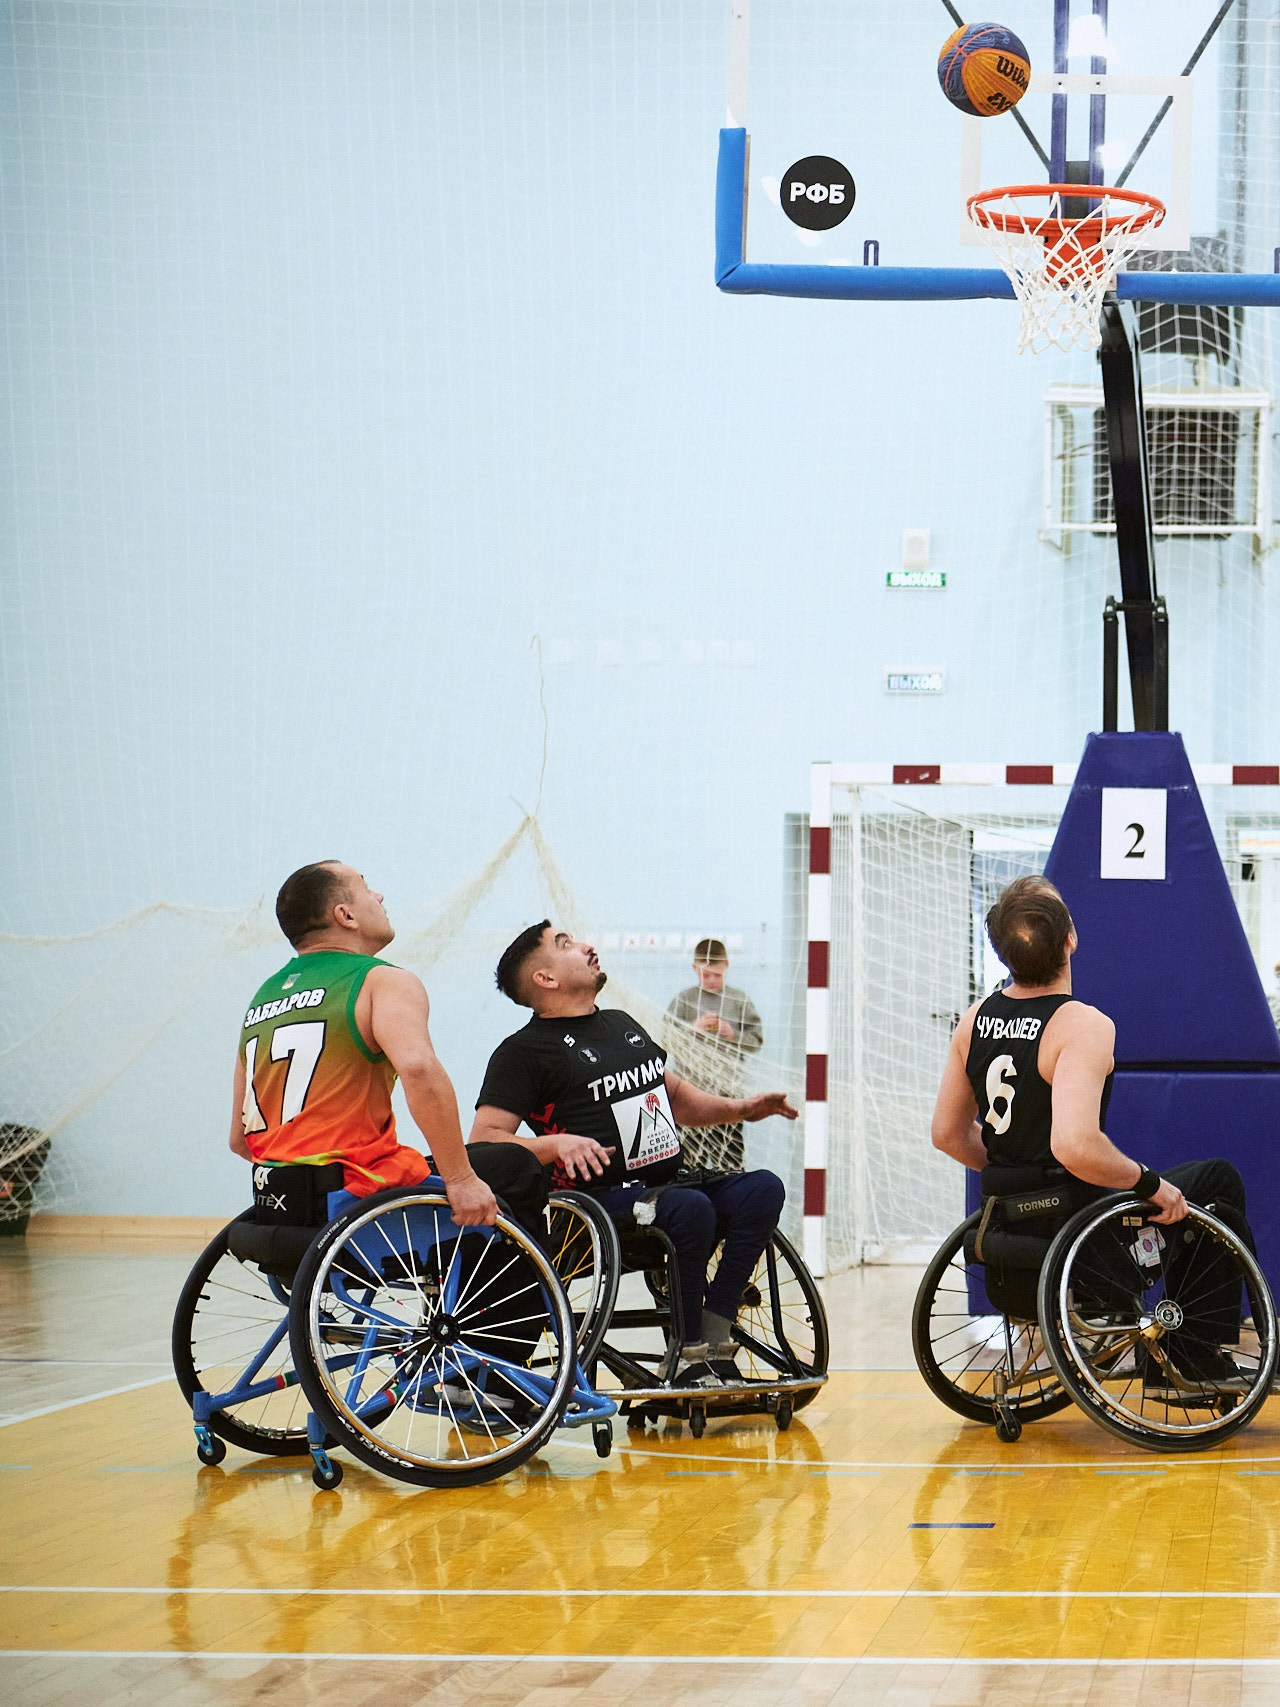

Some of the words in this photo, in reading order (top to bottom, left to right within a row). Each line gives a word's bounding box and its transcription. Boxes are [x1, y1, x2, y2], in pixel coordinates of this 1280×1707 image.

[789, 181, 845, 205] РФБ
[1124, 822, 1146, 859] 2
[244, 988, 327, 1029] ЗАББАРОВ
[976, 1015, 1042, 1041] ЧУВАШЕВ
[241, 1019, 328, 1137] 17
[587, 1056, 665, 1102] ТРИУМФ
[984, 1054, 1018, 1135] 6
[1017, 1196, 1060, 1214] TORNEO
